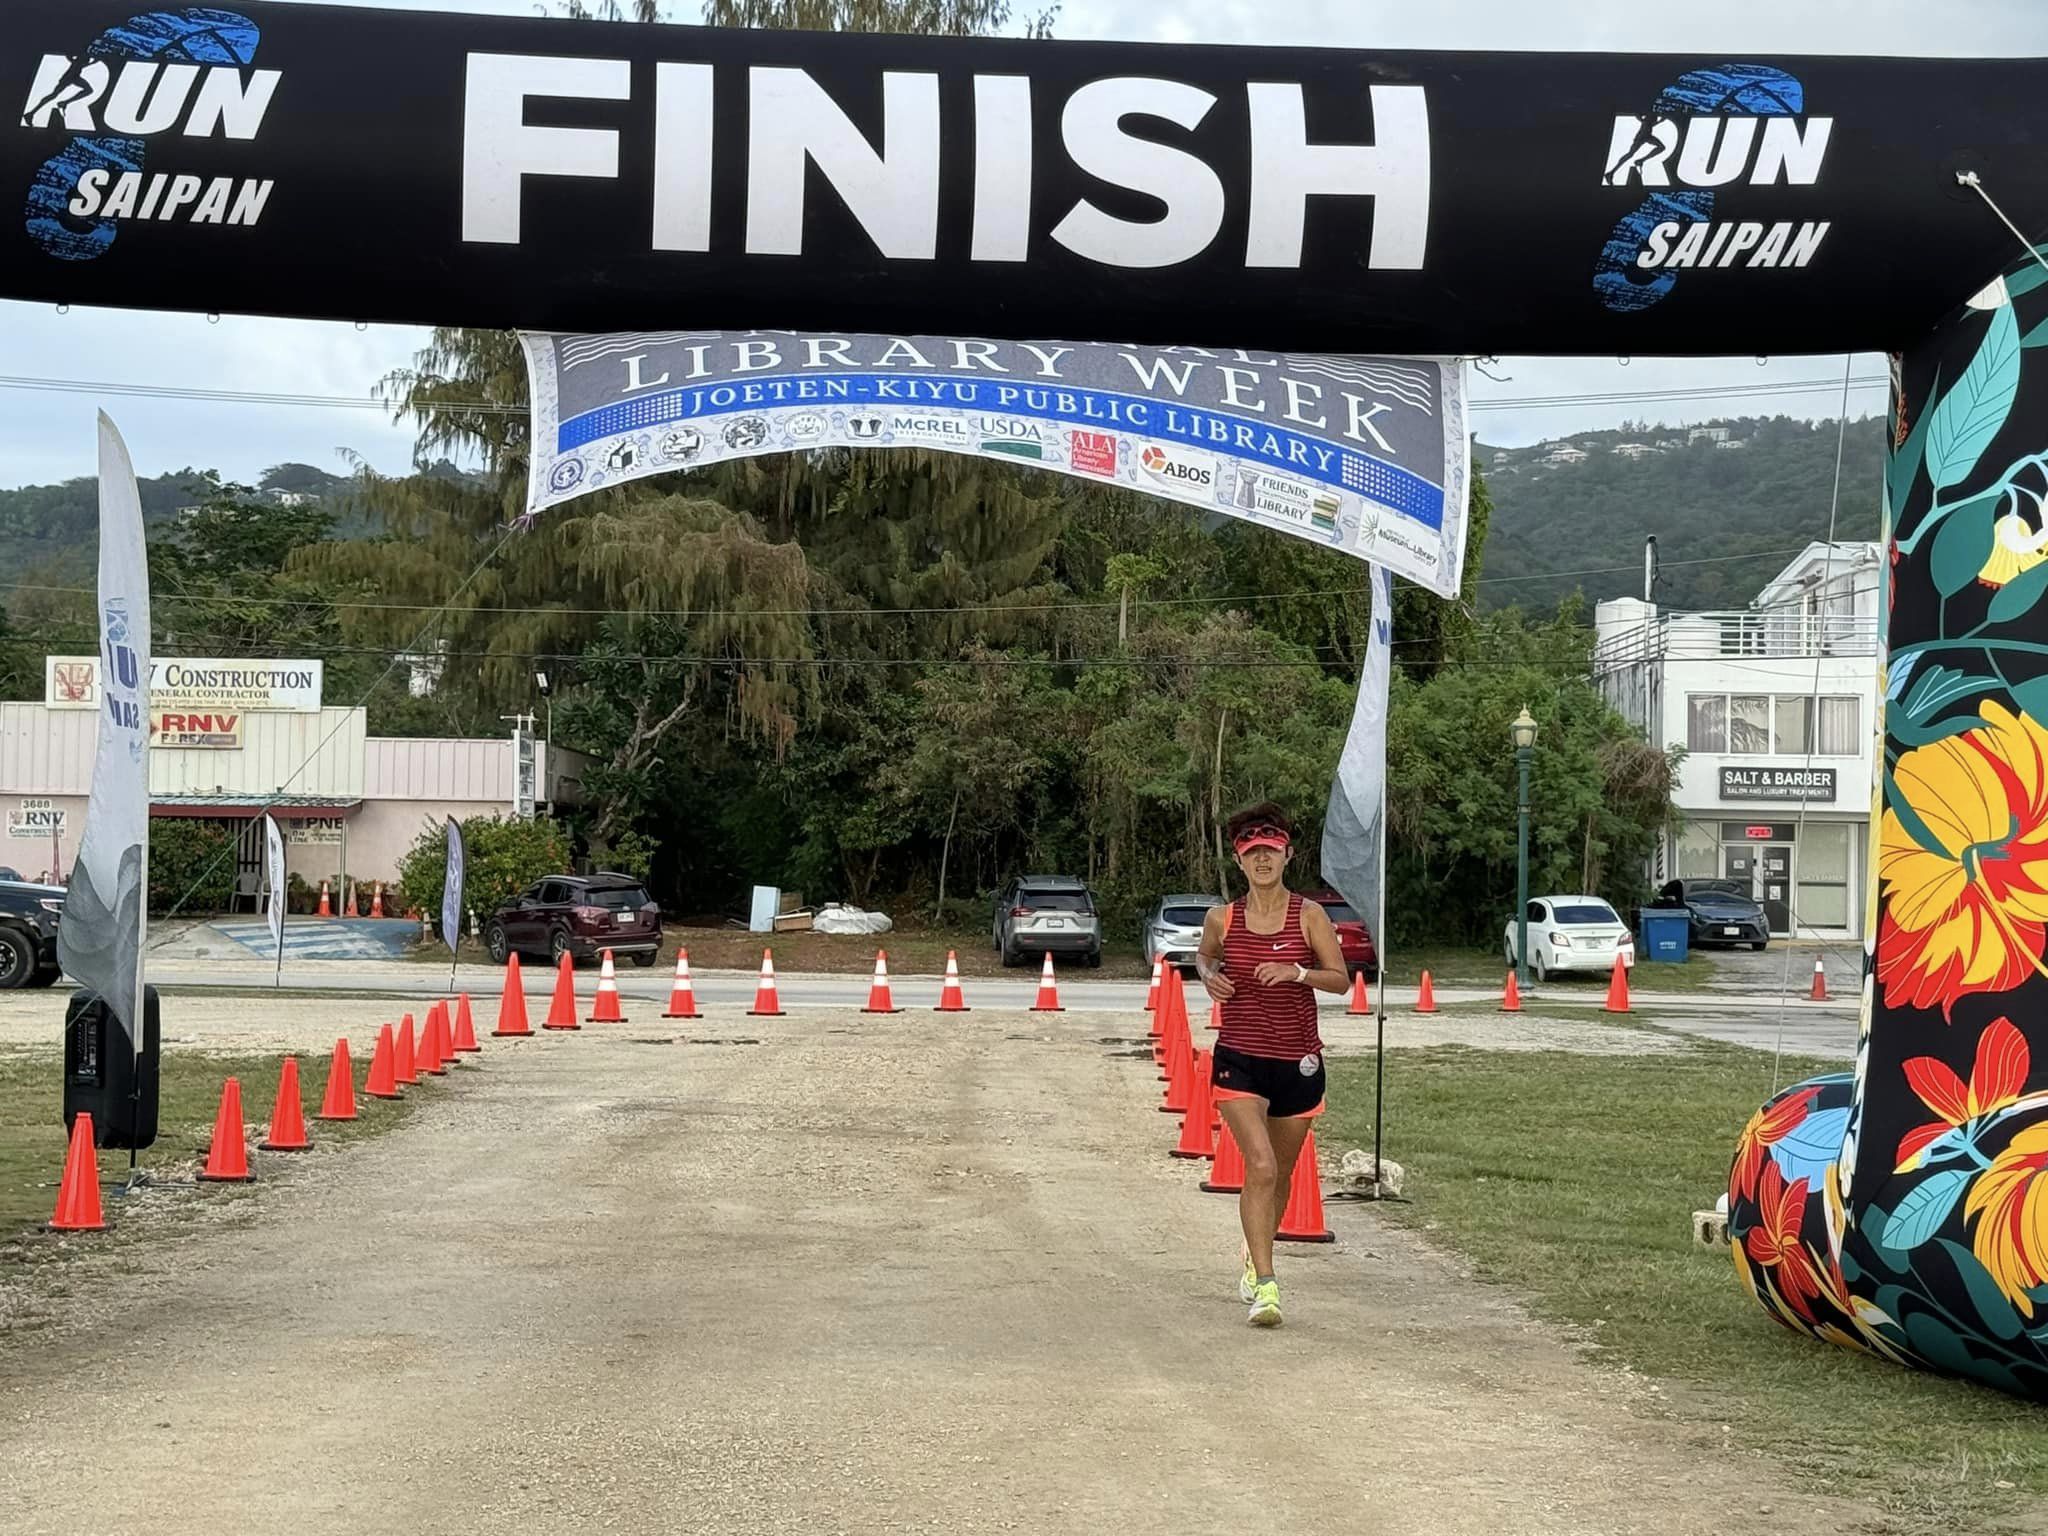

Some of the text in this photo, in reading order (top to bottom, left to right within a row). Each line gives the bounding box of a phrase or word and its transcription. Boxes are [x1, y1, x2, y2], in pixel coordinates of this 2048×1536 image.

[20, 54, 283, 140] RUN
[462, 52, 1431, 269] FINISH
[1601, 114, 1834, 187] RUN
[68, 169, 274, 226] SAIPAN
[1636, 221, 1831, 268] SAIPAN
[620, 338, 1397, 454] LIBRARY WEEK
[691, 379, 1335, 472] JOETEN-KIYU PUBLIC LIBRARY
[980, 417, 1042, 440] USDA
[1073, 431, 1114, 454] ALA
[1163, 461, 1211, 485] ABOS
[1262, 476, 1309, 499] FRIENDS
[1256, 497, 1309, 521] LIBRARY
[150, 688, 270, 699] ENERAL CONTRACTOR
[162, 713, 239, 733] RNV
[1724, 771, 1832, 786] SALT & BARBER
[1789, 788, 1830, 797] TREAMENTS
[25, 811, 65, 825] RNV
